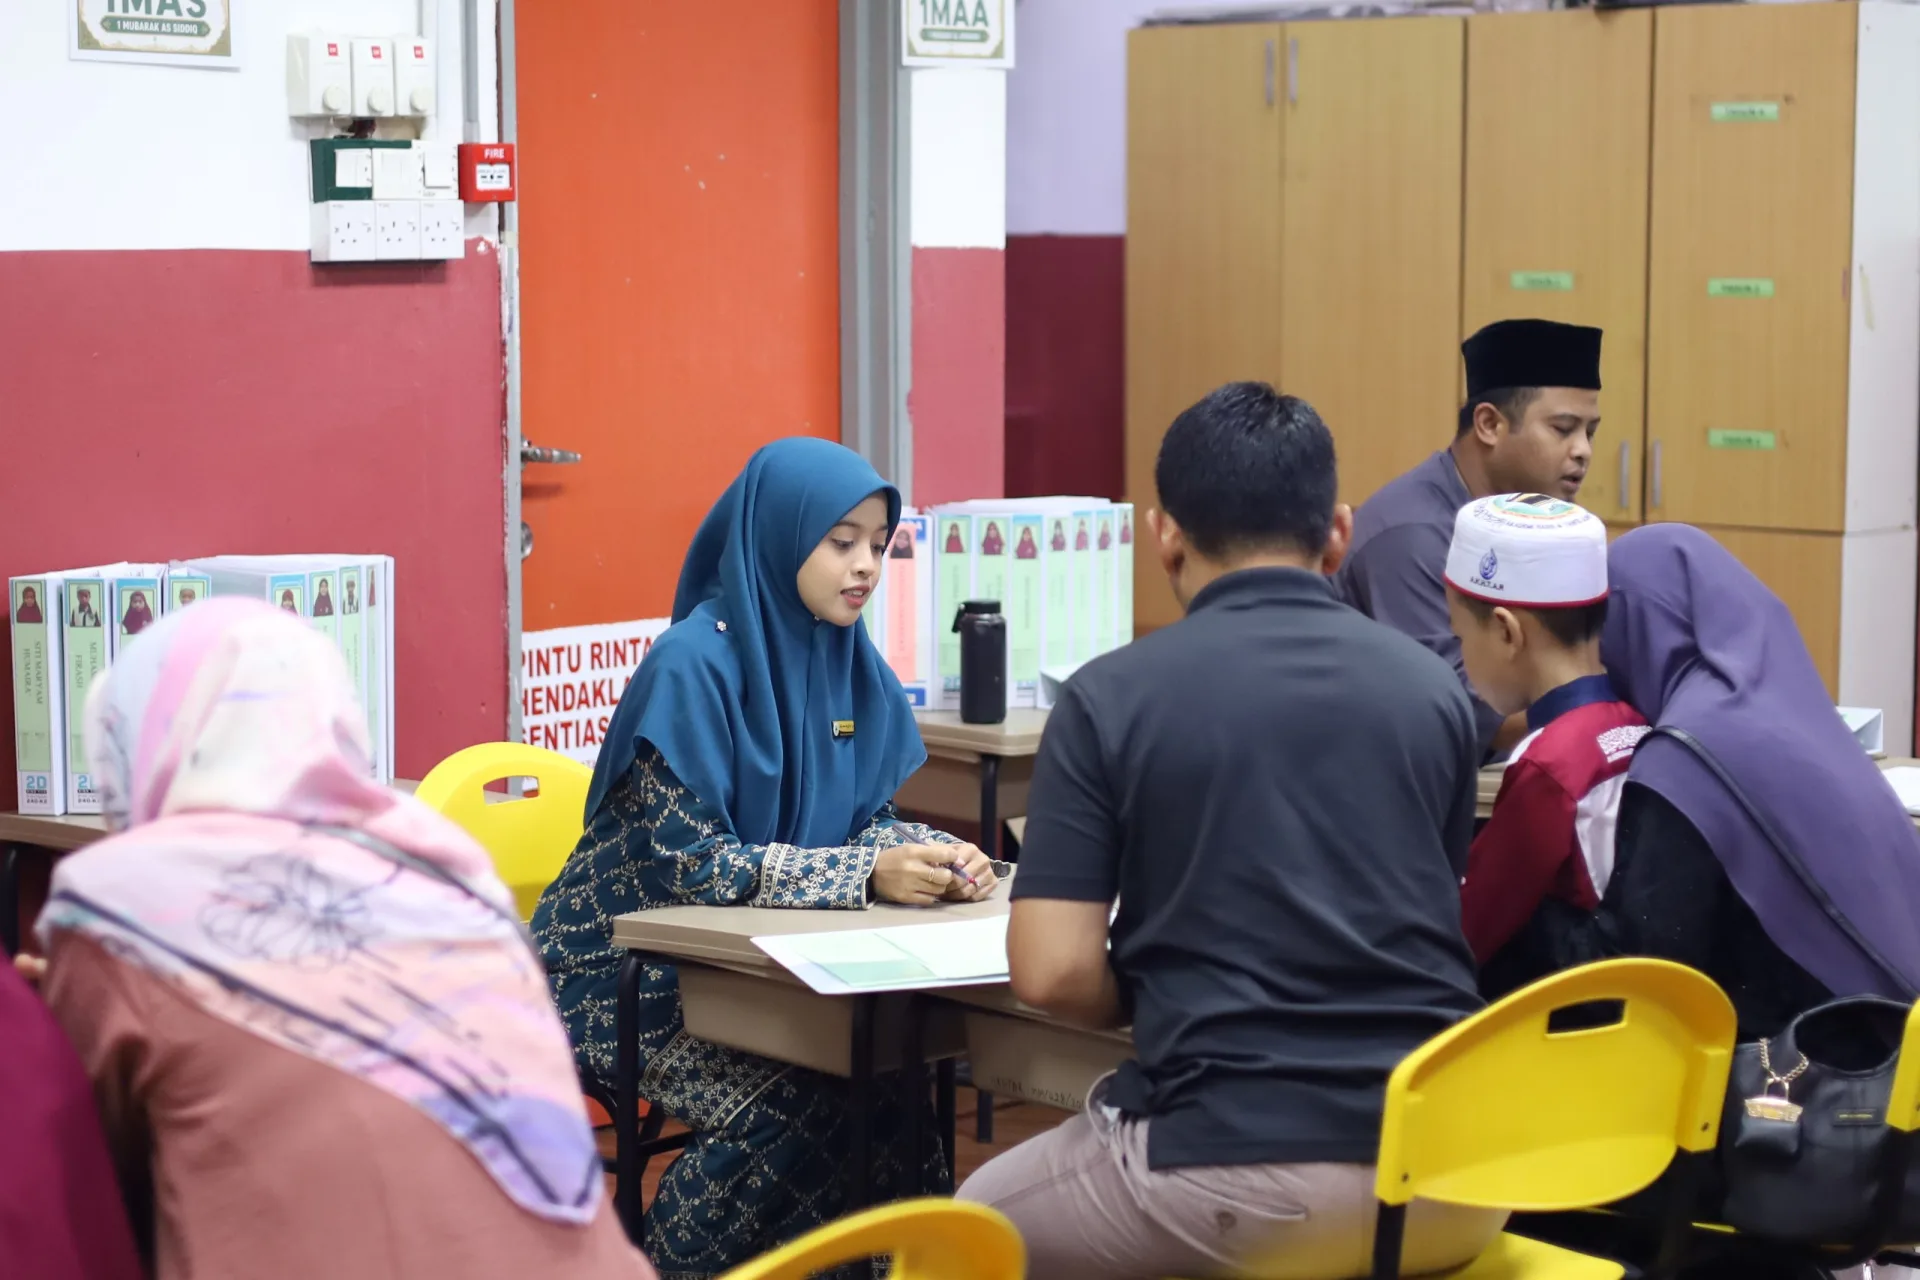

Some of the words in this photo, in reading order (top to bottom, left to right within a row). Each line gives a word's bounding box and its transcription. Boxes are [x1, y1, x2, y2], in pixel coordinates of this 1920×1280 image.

[122, 20, 160, 32] MUBARAK
[161, 22, 172, 32] AS
[172, 22, 198, 34] SIDDIQ
[484, 148, 505, 159] FIRE
[35, 660, 43, 704] MARYAM
[75, 654, 84, 689] FIRASH
[522, 676, 631, 717] HENDAKL
[26, 775, 47, 789] 2D
